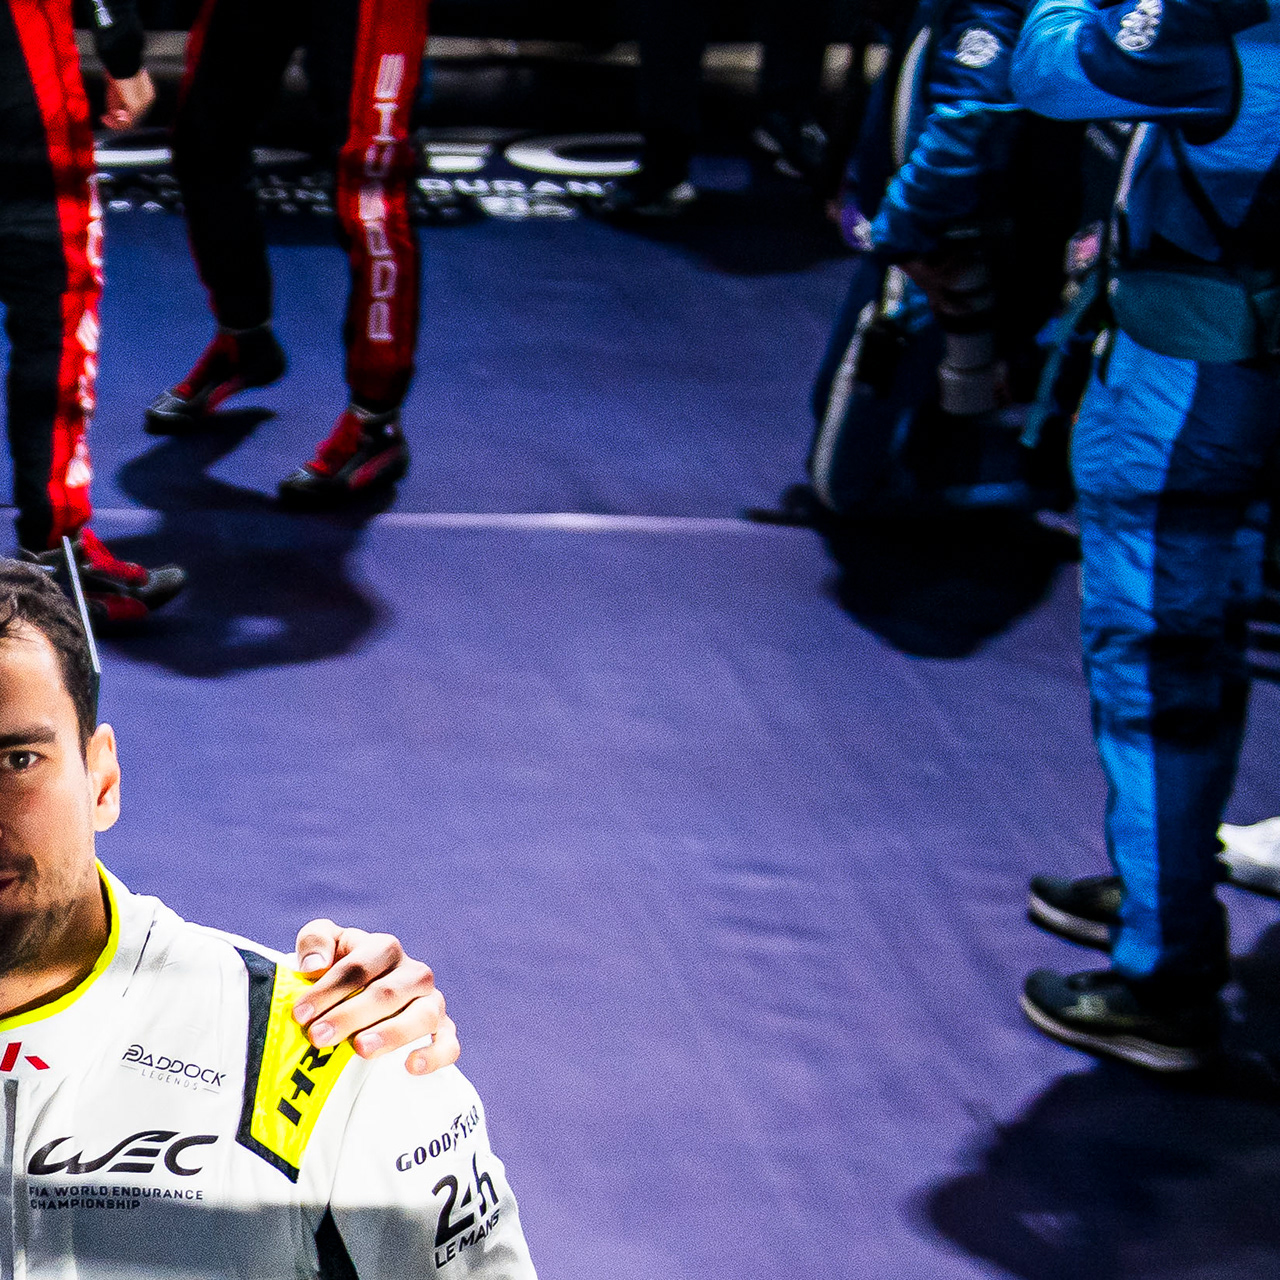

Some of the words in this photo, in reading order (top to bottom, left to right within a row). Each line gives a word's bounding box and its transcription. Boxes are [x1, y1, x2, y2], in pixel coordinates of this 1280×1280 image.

[122, 1043, 227, 1087] PADDOCK
[141, 1067, 199, 1091] LEGENDS
[276, 1040, 340, 1127] HR
[27, 1130, 219, 1175] WEC
[28, 1186, 49, 1200] FIA
[53, 1185, 107, 1200] WORLD
[112, 1186, 204, 1201] ENDURANCE
[30, 1198, 141, 1210] CHAMPIONSHIP
[435, 1242, 456, 1269] LE
[458, 1208, 500, 1253] MANS
